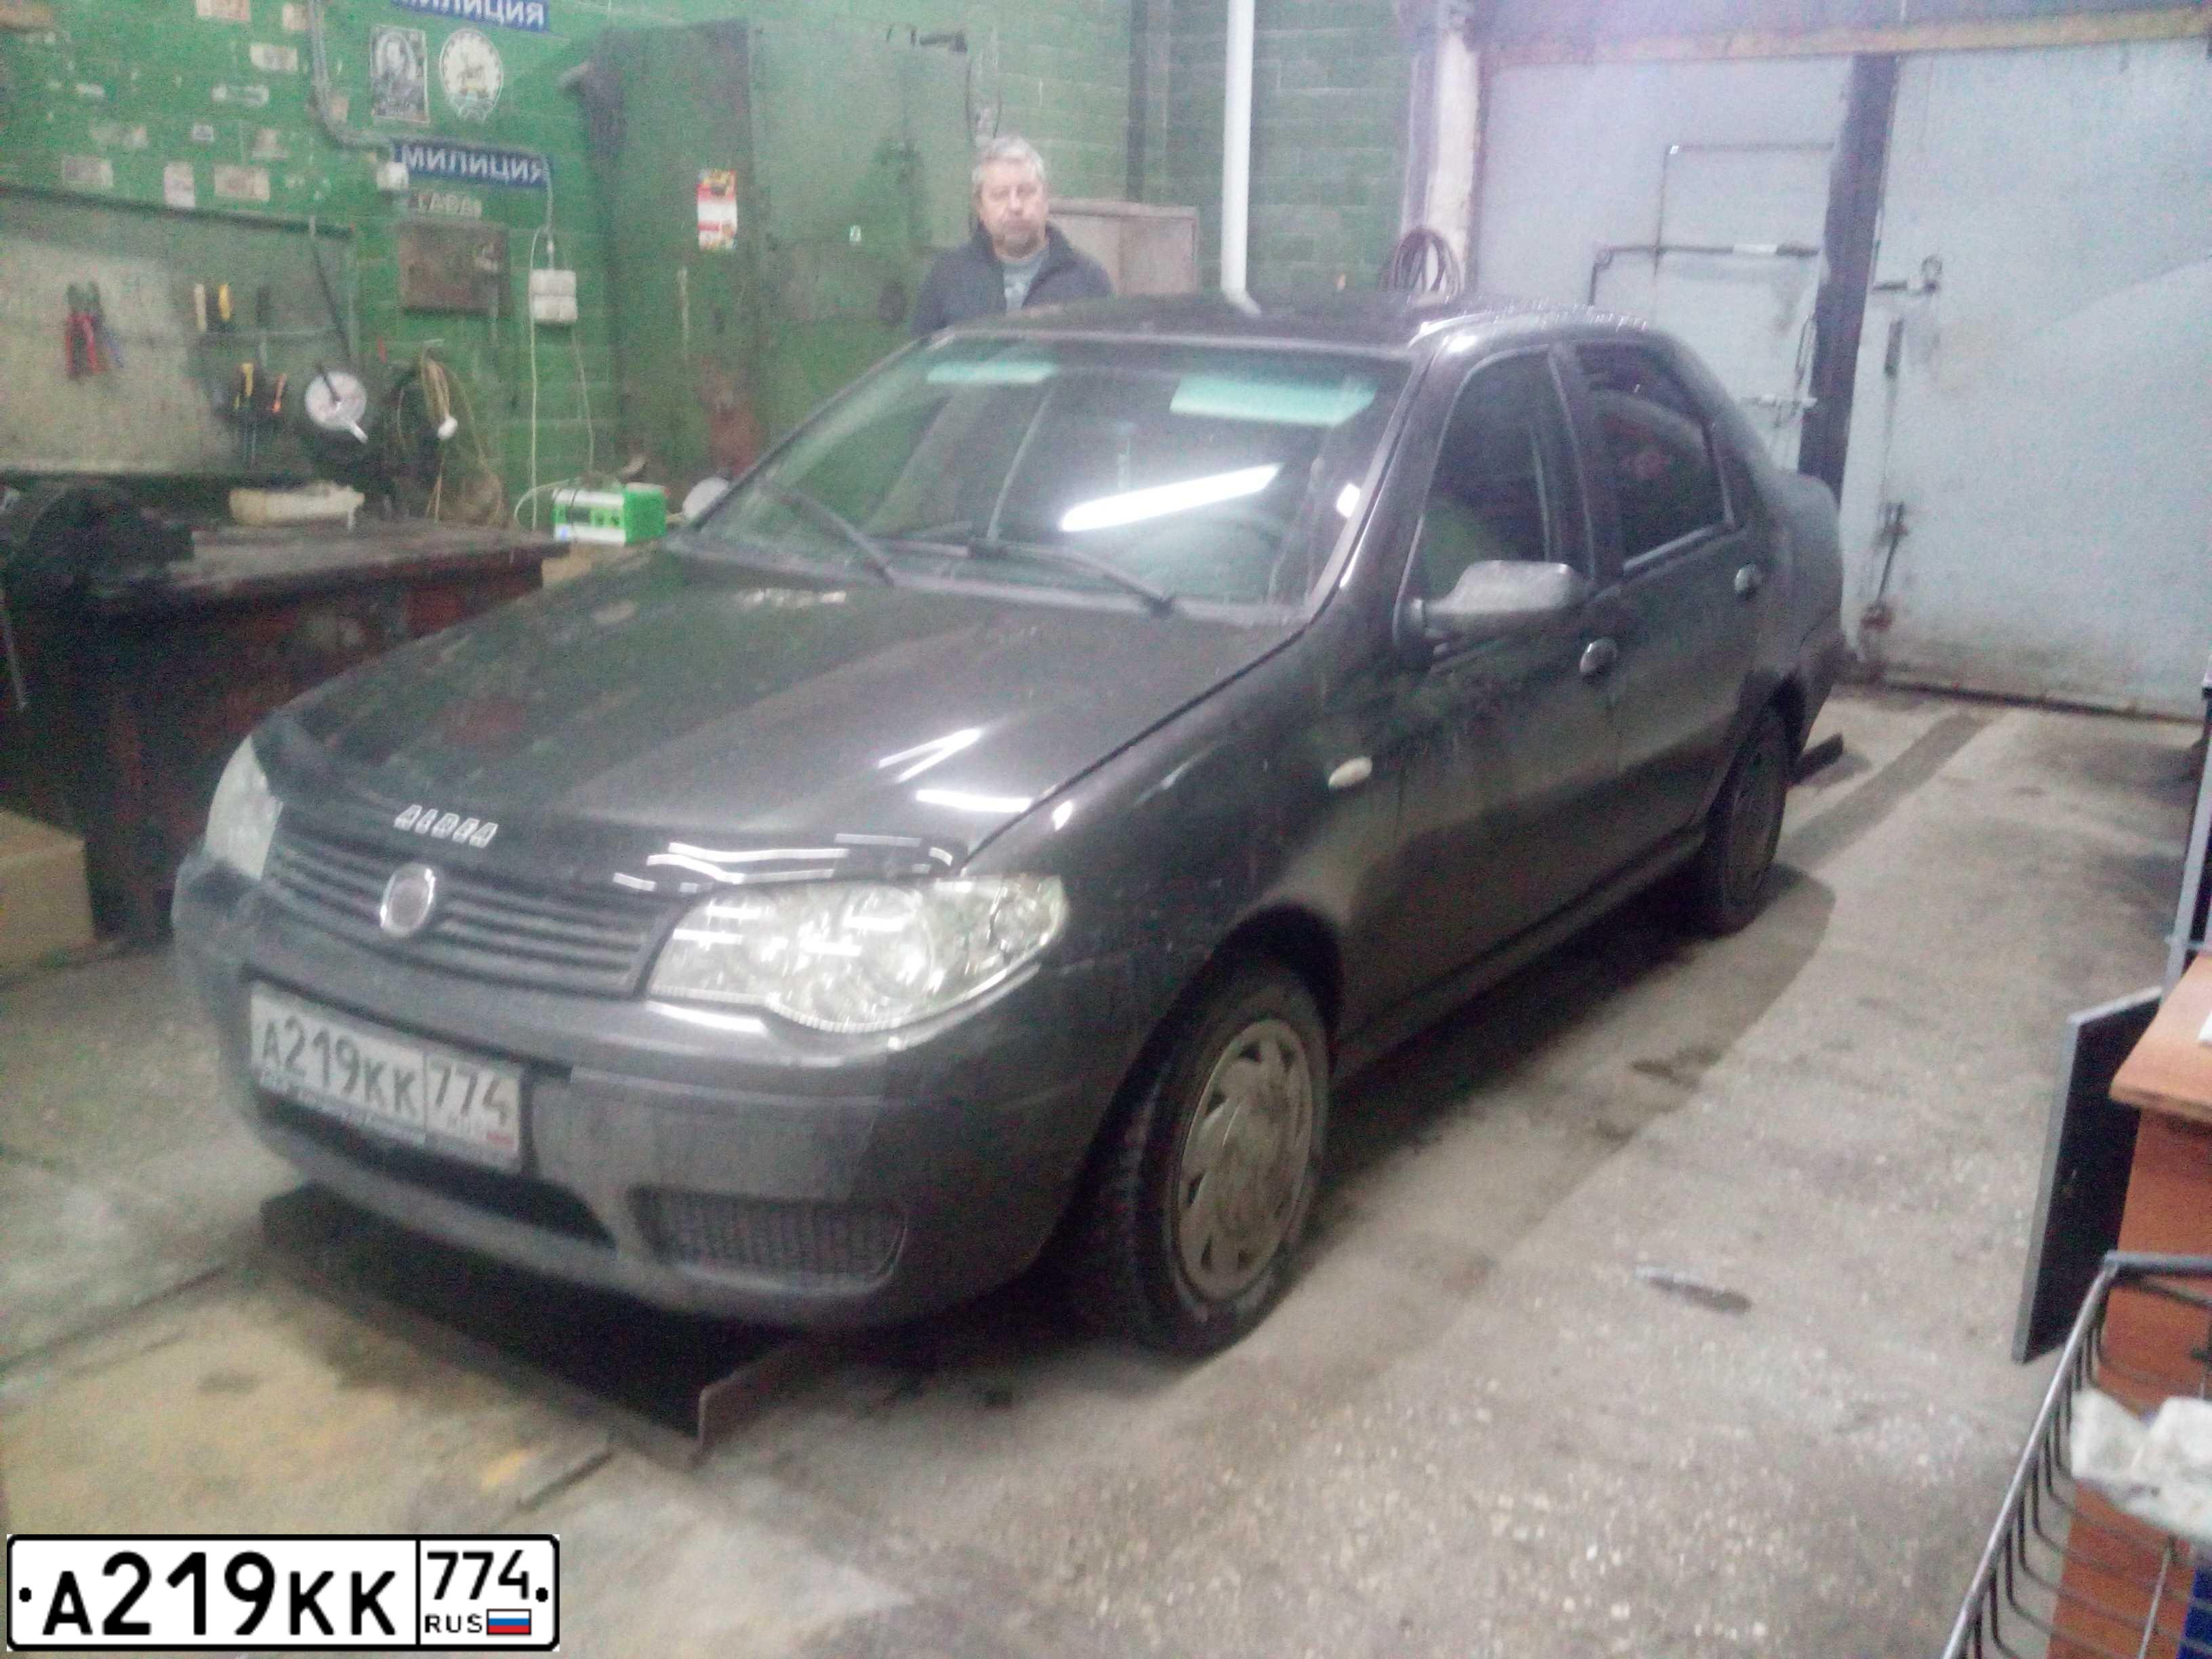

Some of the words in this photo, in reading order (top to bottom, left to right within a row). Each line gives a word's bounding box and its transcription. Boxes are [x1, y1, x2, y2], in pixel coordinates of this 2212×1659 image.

[397, 0, 545, 30] ЛИЦИЯ
[402, 145, 545, 184] МИЛИЦИЯ
[427, 1056, 510, 1126] 774
